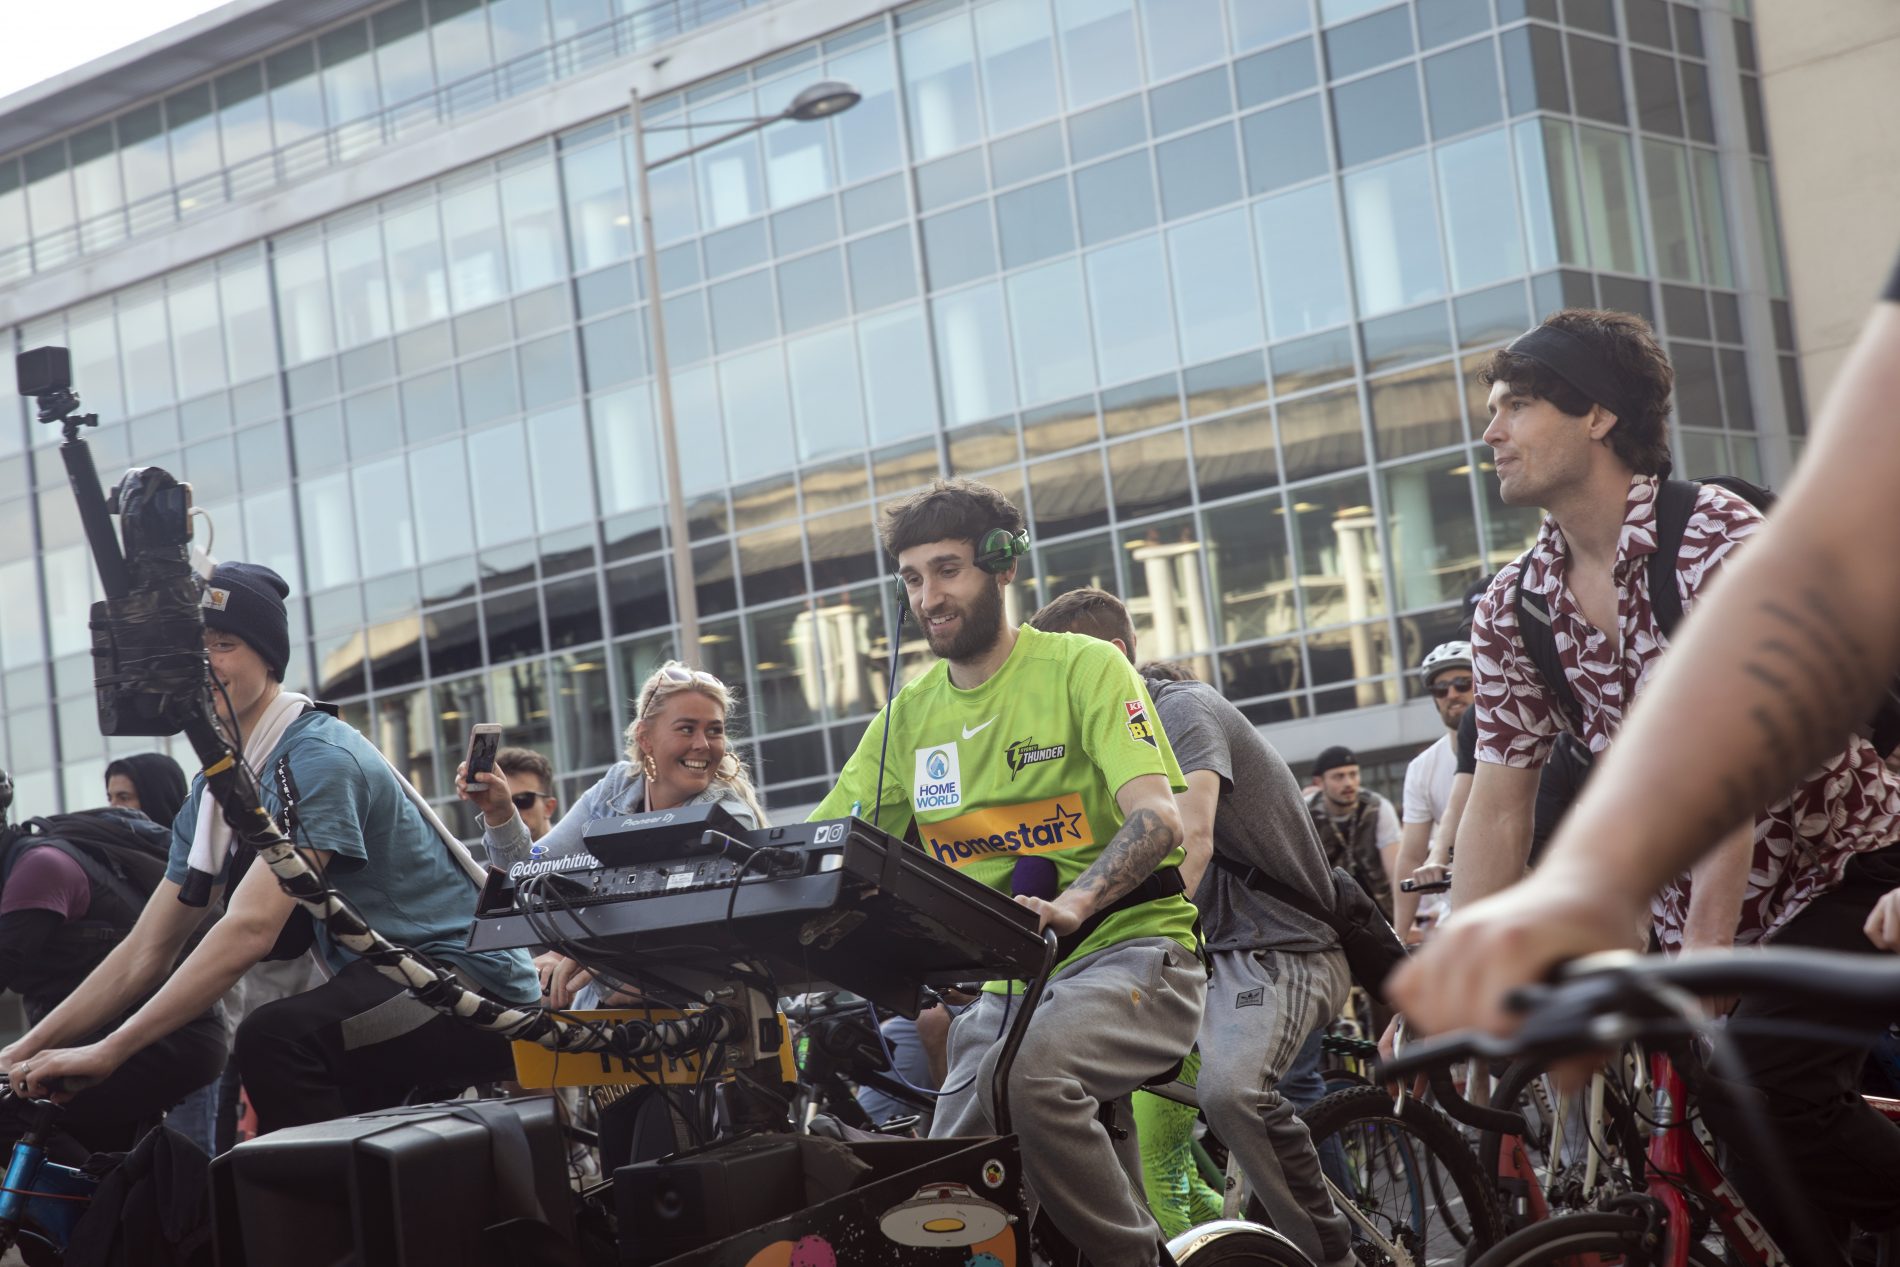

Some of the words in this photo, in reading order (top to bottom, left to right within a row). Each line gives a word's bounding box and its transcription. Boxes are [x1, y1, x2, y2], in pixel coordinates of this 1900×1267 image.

[1023, 746, 1064, 764] THUNDER
[919, 782, 956, 796] HOME
[916, 793, 960, 808] WORLD
[620, 816, 662, 828] Pioneer
[930, 821, 1065, 864] homestar
[509, 852, 599, 881] @domwhiting
